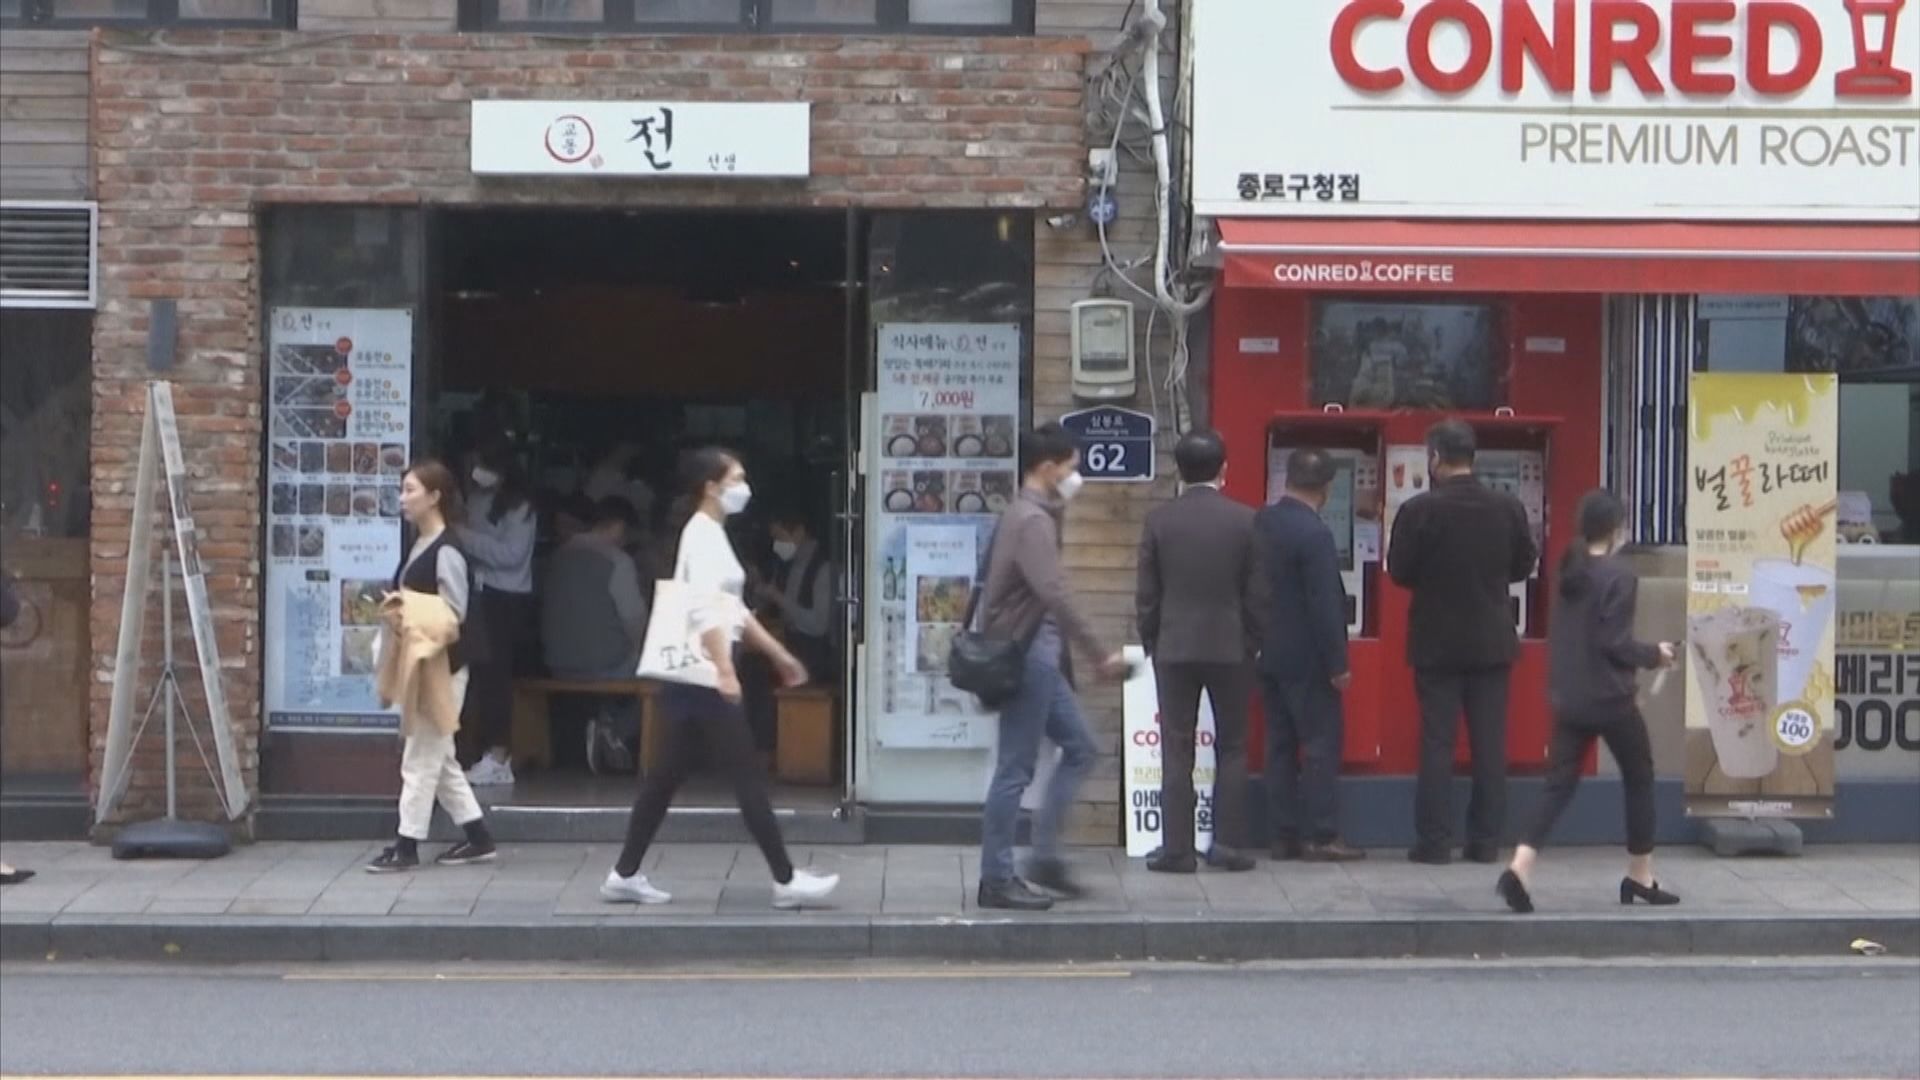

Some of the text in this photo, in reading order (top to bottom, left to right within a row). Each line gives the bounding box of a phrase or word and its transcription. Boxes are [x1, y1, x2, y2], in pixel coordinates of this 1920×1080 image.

[1330, 0, 1823, 94] CONRED
[625, 107, 673, 170] 전
[1520, 123, 1737, 164] PREMIUM
[1236, 172, 1361, 202] 종로구청점
[1274, 264, 1454, 283] CONRED COFFEE
[920, 389, 974, 410] 7,000원
[1087, 443, 1127, 472] 62
[1779, 720, 1810, 739] 100
